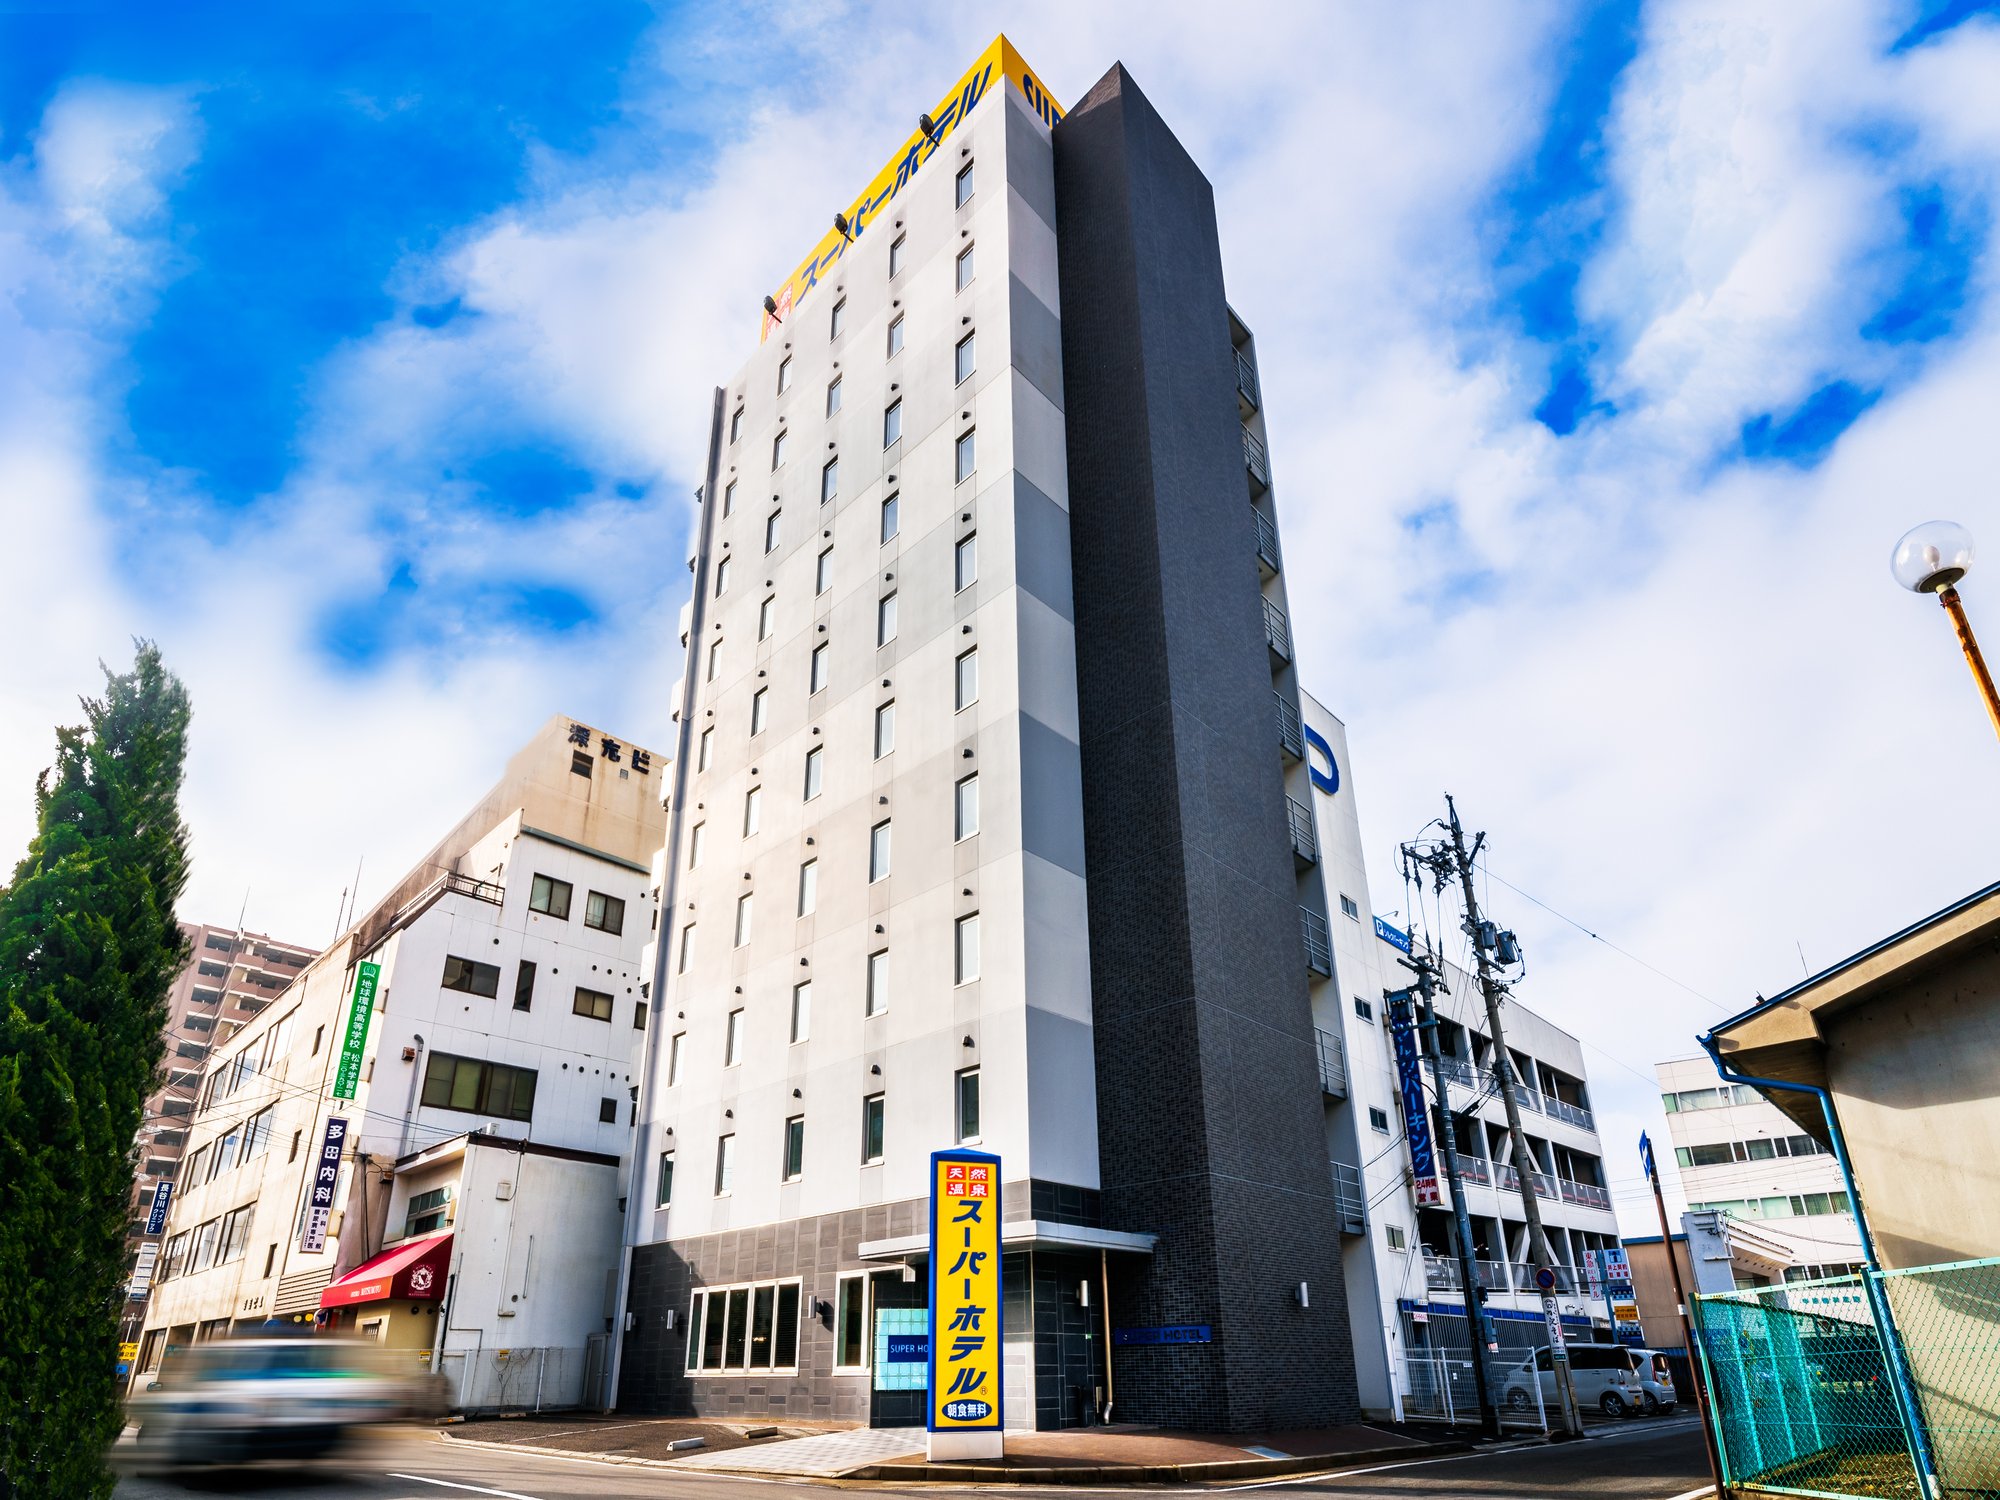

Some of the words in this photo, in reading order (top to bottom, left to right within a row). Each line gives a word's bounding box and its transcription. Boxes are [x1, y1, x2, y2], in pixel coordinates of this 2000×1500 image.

[795, 61, 993, 308] スーパーホテル
[348, 979, 373, 1049] 地球環境高等学校
[343, 1053, 361, 1098] 松本学習室
[314, 1124, 344, 1203] 多田内科
[948, 1167, 987, 1180] 天然
[156, 1183, 169, 1208] 長谷川
[948, 1183, 987, 1197] 温泉
[315, 1209, 329, 1249] 内科一般
[946, 1200, 988, 1395] スーパーホテル
[890, 1344, 915, 1353] SUPER
[1163, 1329, 1204, 1340] HOTEL
[947, 1403, 987, 1418] 朝食無料
